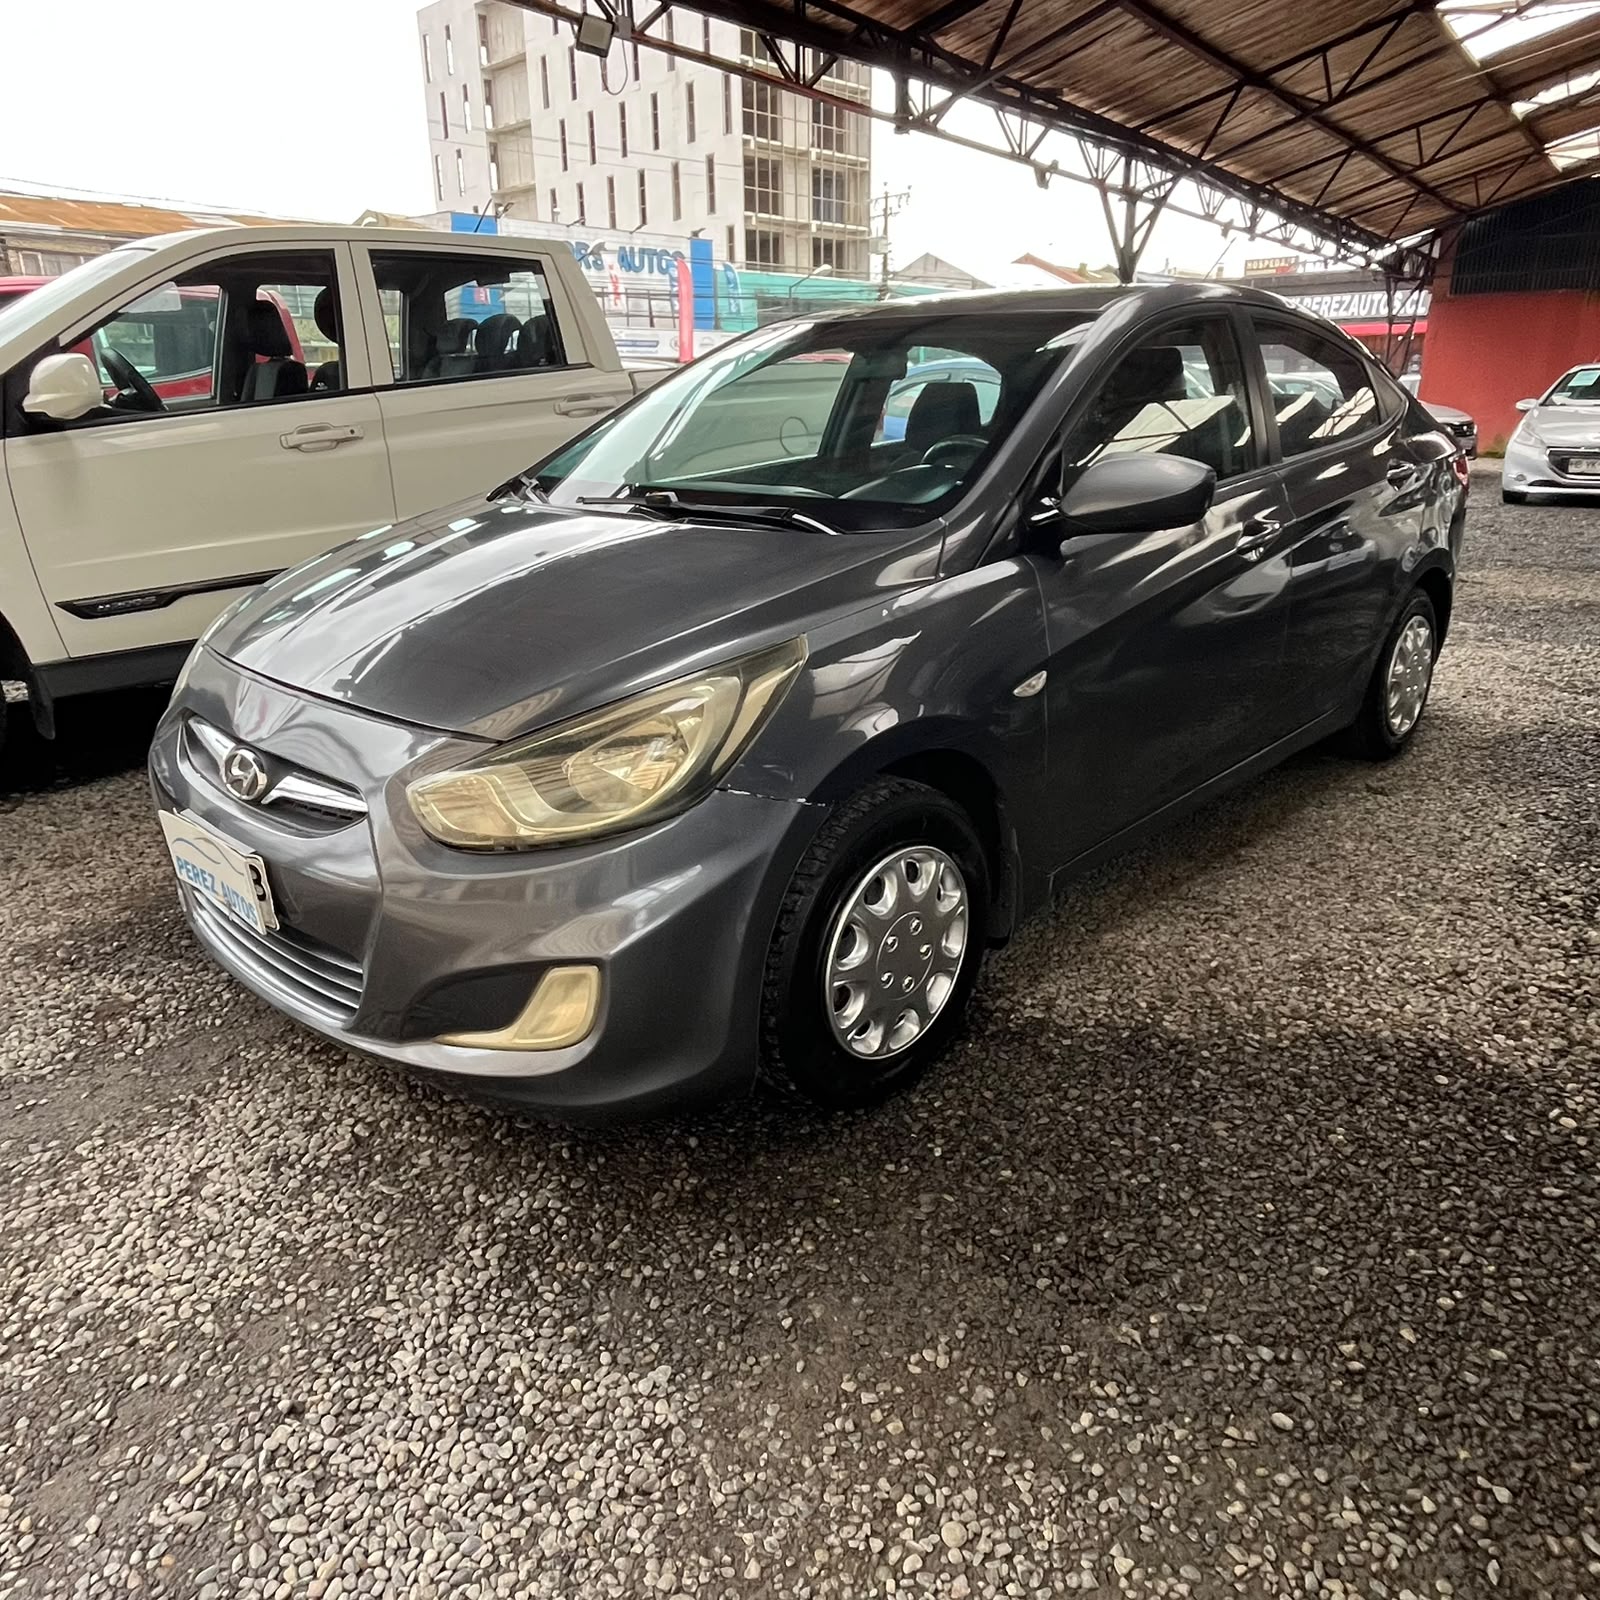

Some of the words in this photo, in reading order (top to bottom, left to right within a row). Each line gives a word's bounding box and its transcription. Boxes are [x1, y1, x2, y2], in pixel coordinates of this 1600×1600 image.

[567, 239, 605, 271] RS
[1289, 291, 1429, 318] PEREZAUTOS.CL
[175, 855, 219, 895] PEREZ
[220, 880, 258, 927] AUTOS
